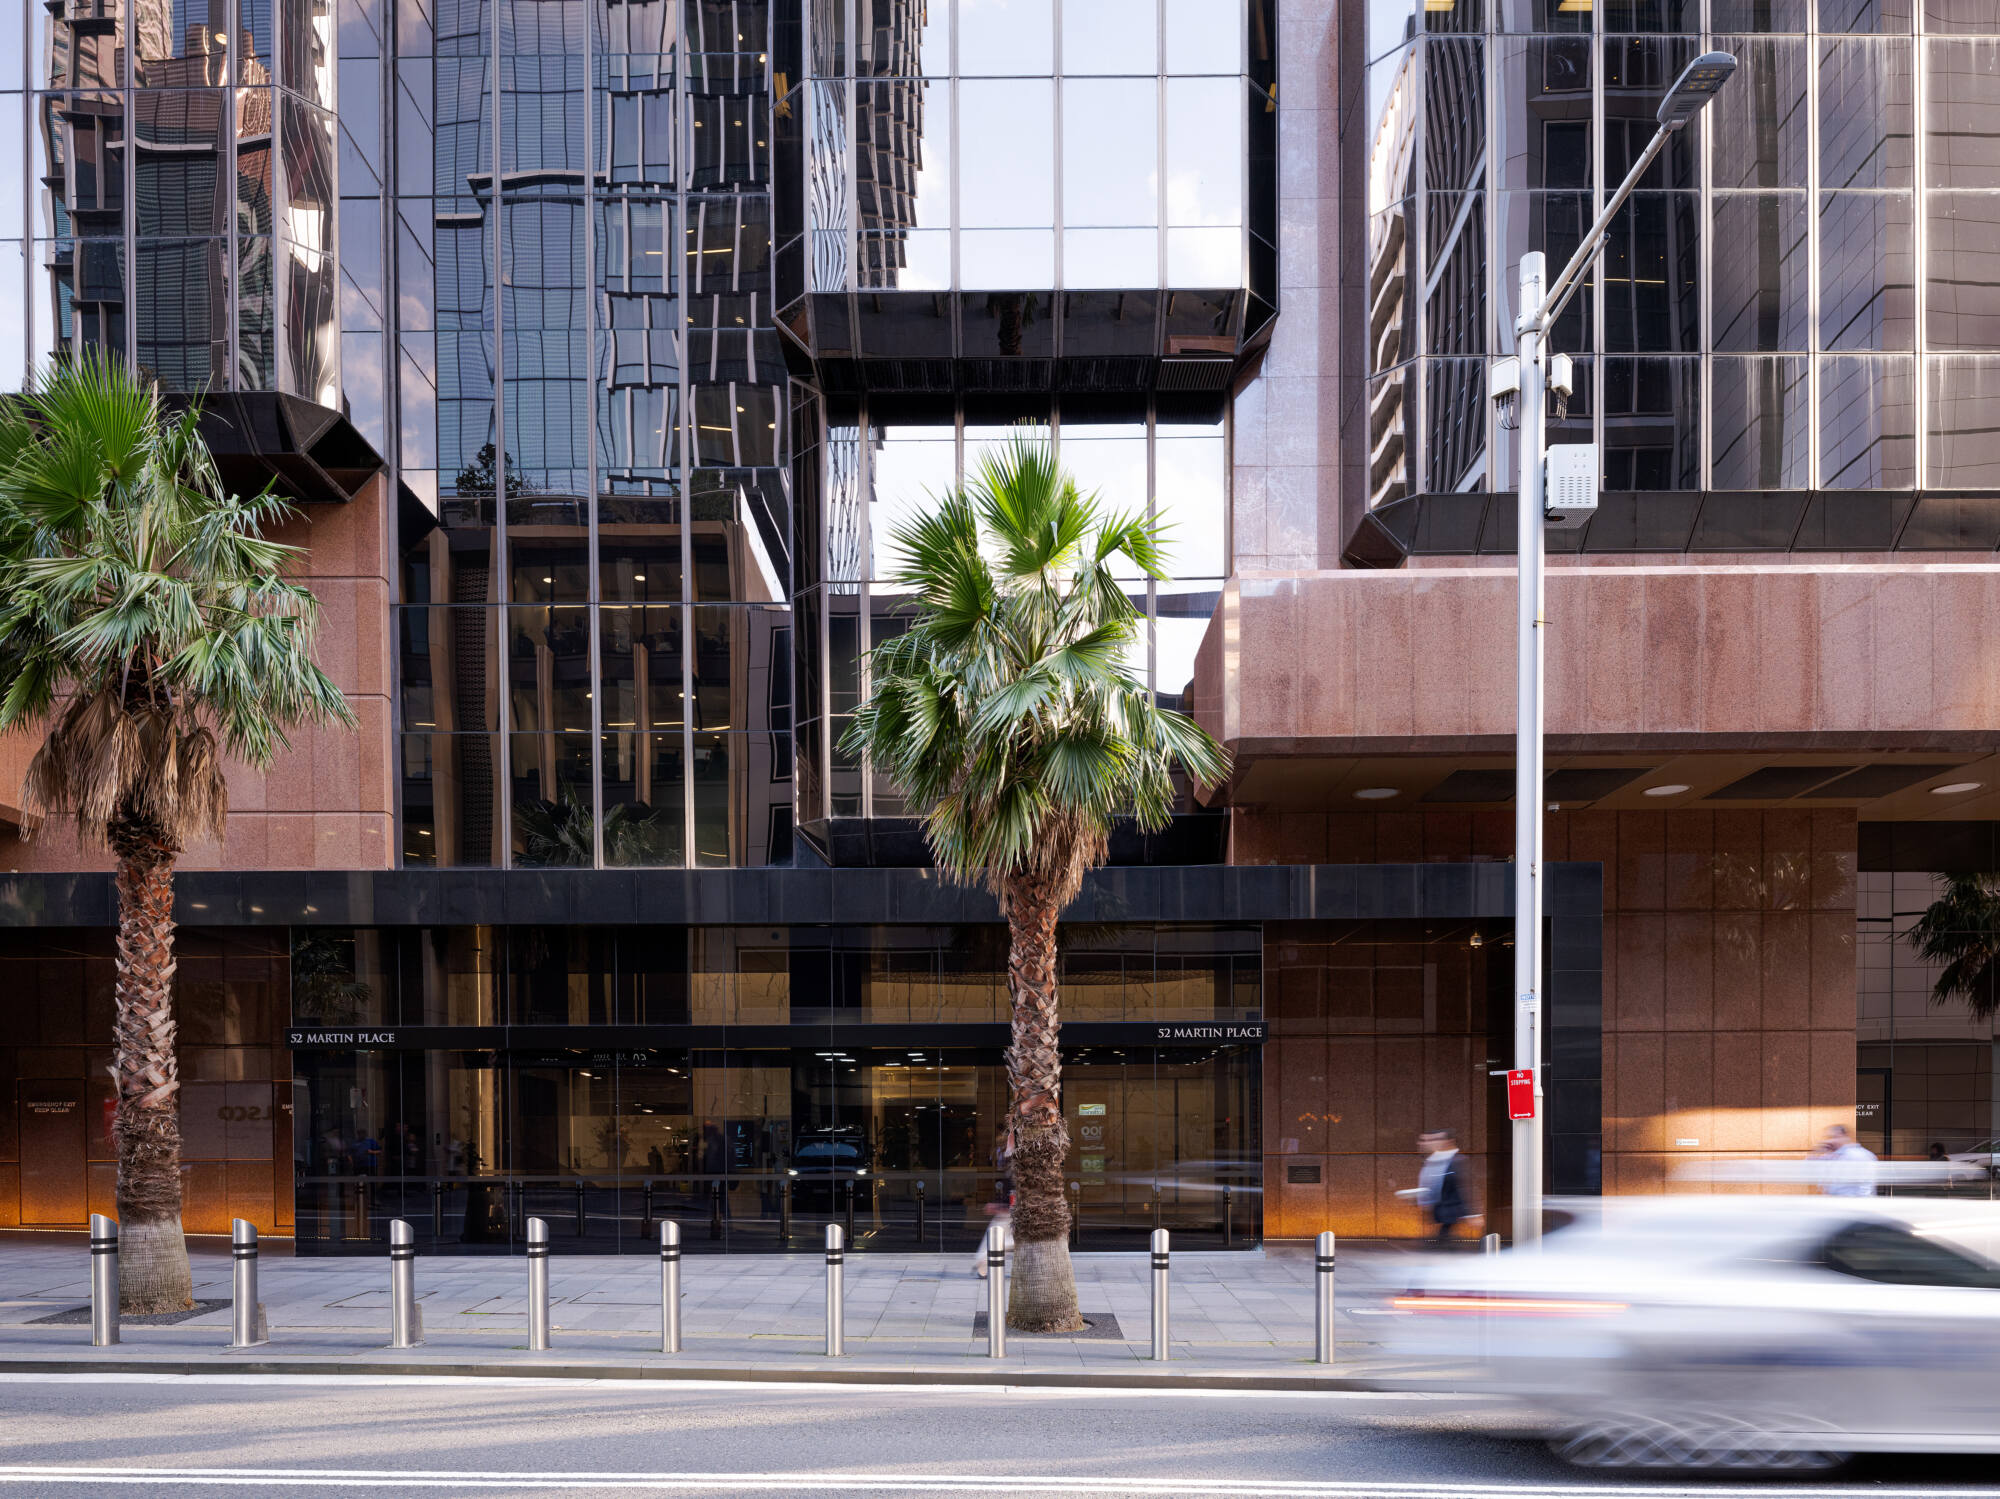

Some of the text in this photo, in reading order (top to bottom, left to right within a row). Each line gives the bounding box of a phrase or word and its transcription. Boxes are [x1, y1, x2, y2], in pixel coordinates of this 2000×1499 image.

[1158, 1027, 1262, 1038] 52 MARTIN PLACE
[290, 1033, 395, 1043] 52 MARTIN PLACE
